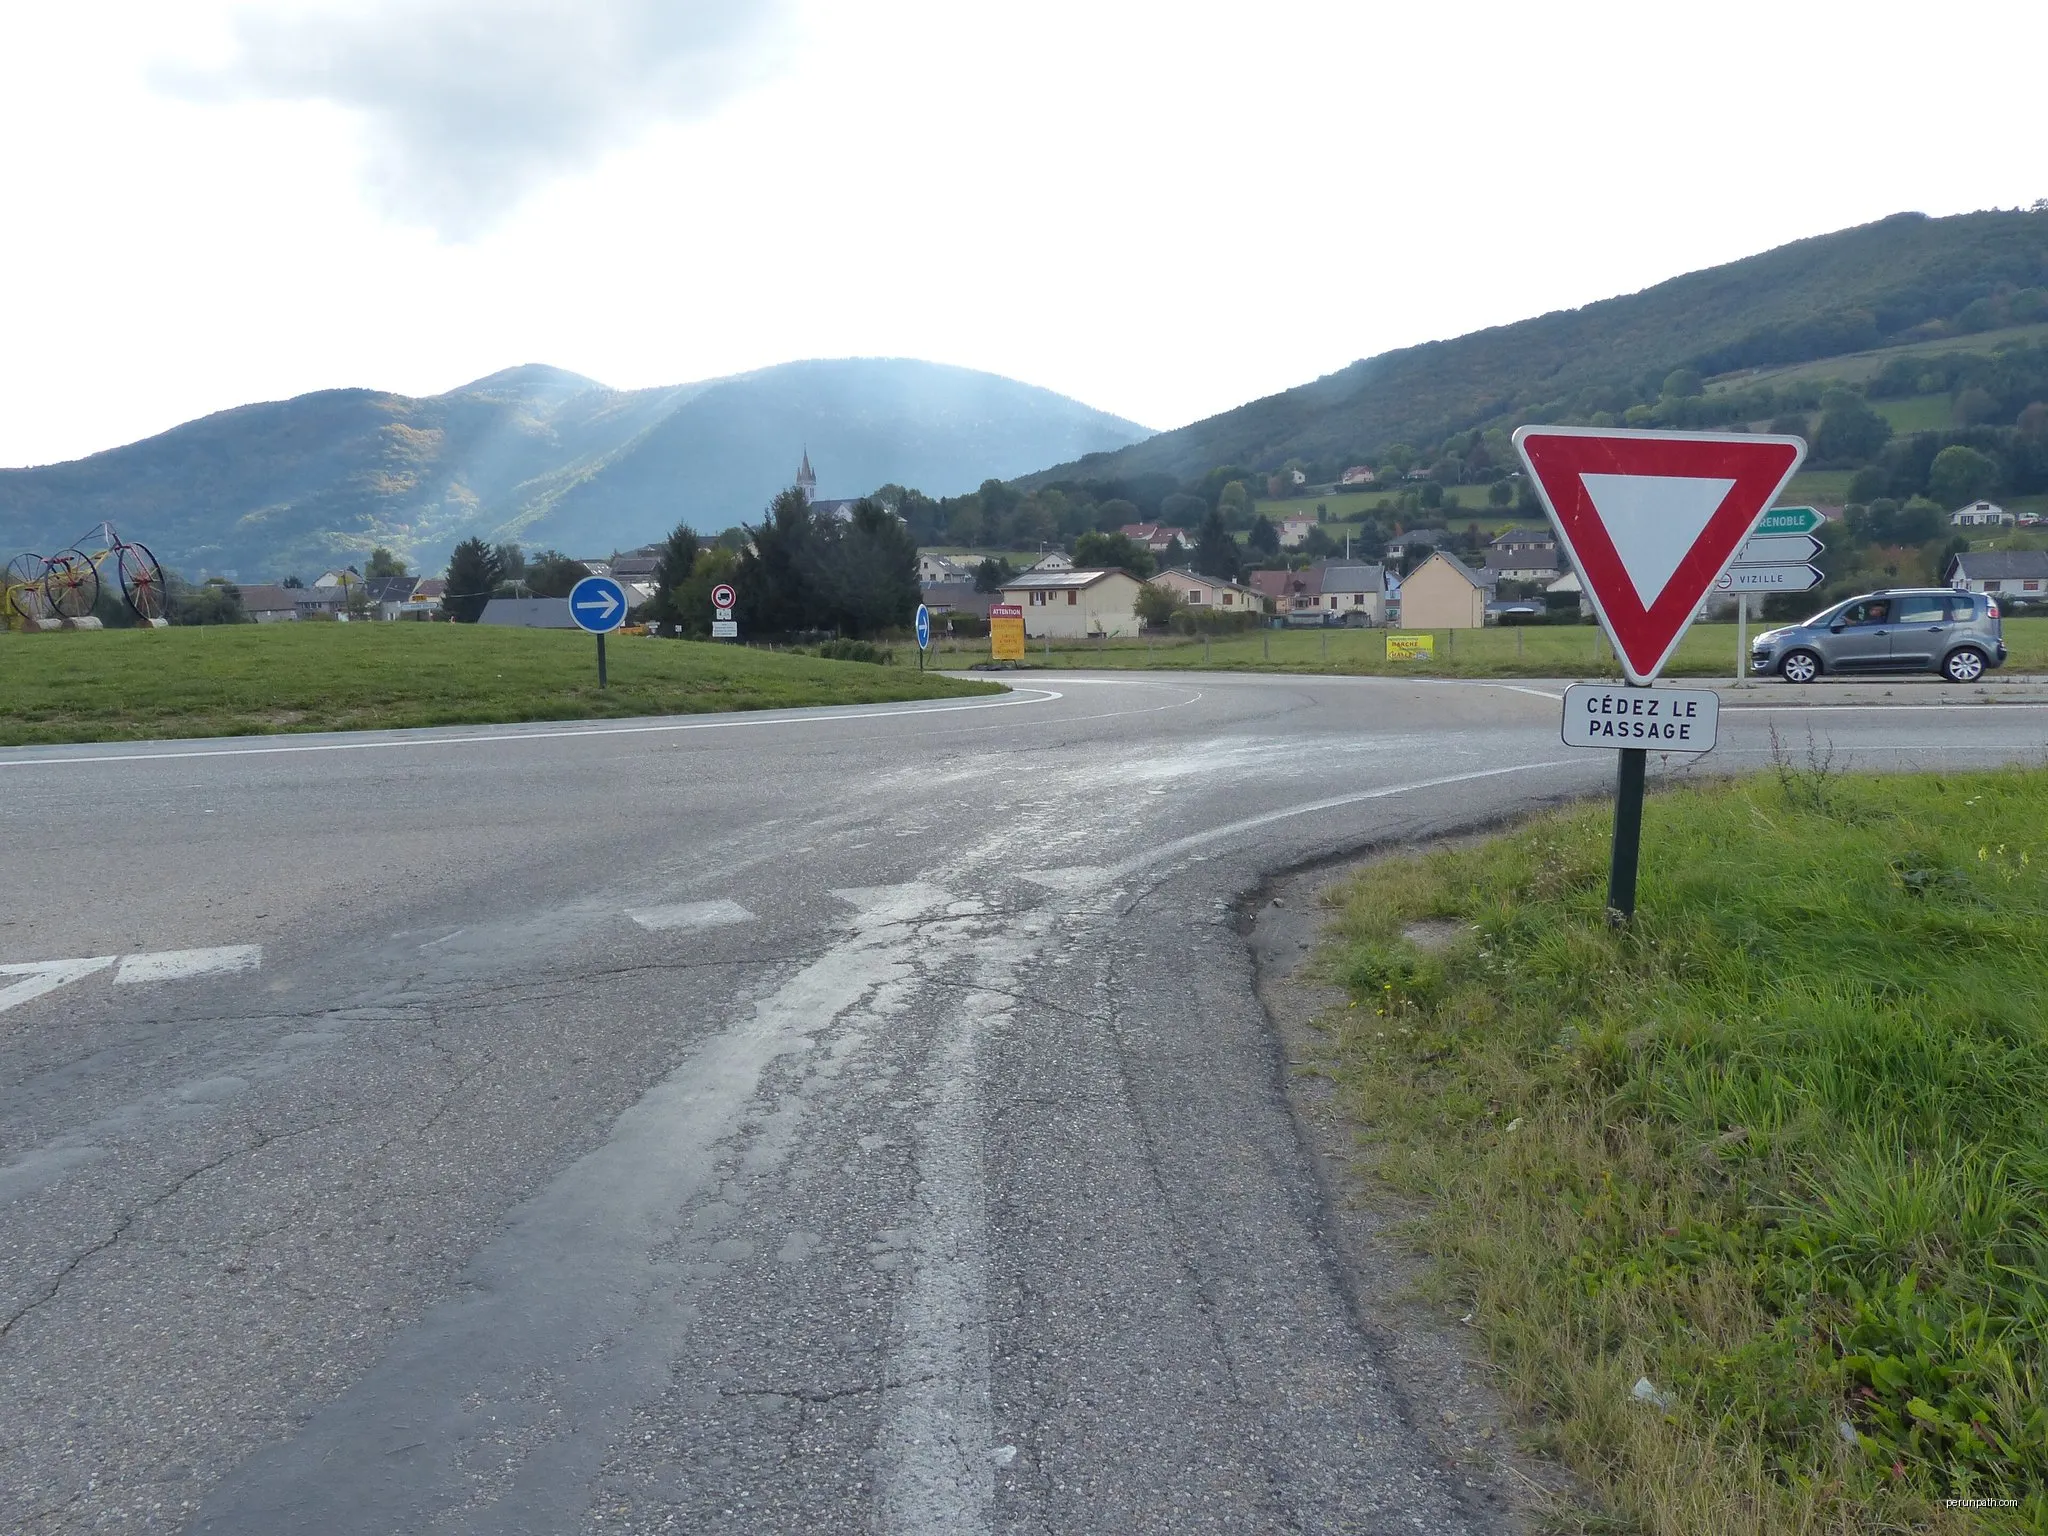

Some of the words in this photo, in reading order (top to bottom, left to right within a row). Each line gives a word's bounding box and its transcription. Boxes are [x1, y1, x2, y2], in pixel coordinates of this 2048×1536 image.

[1759, 515, 1805, 528] RENOBLE
[1740, 574, 1783, 583] VIZILLE
[992, 608, 1021, 616] ATTENTION
[1587, 694, 1660, 716] CÉDEZ
[1672, 701, 1697, 718] LE
[1589, 720, 1691, 740] PASSAGE
